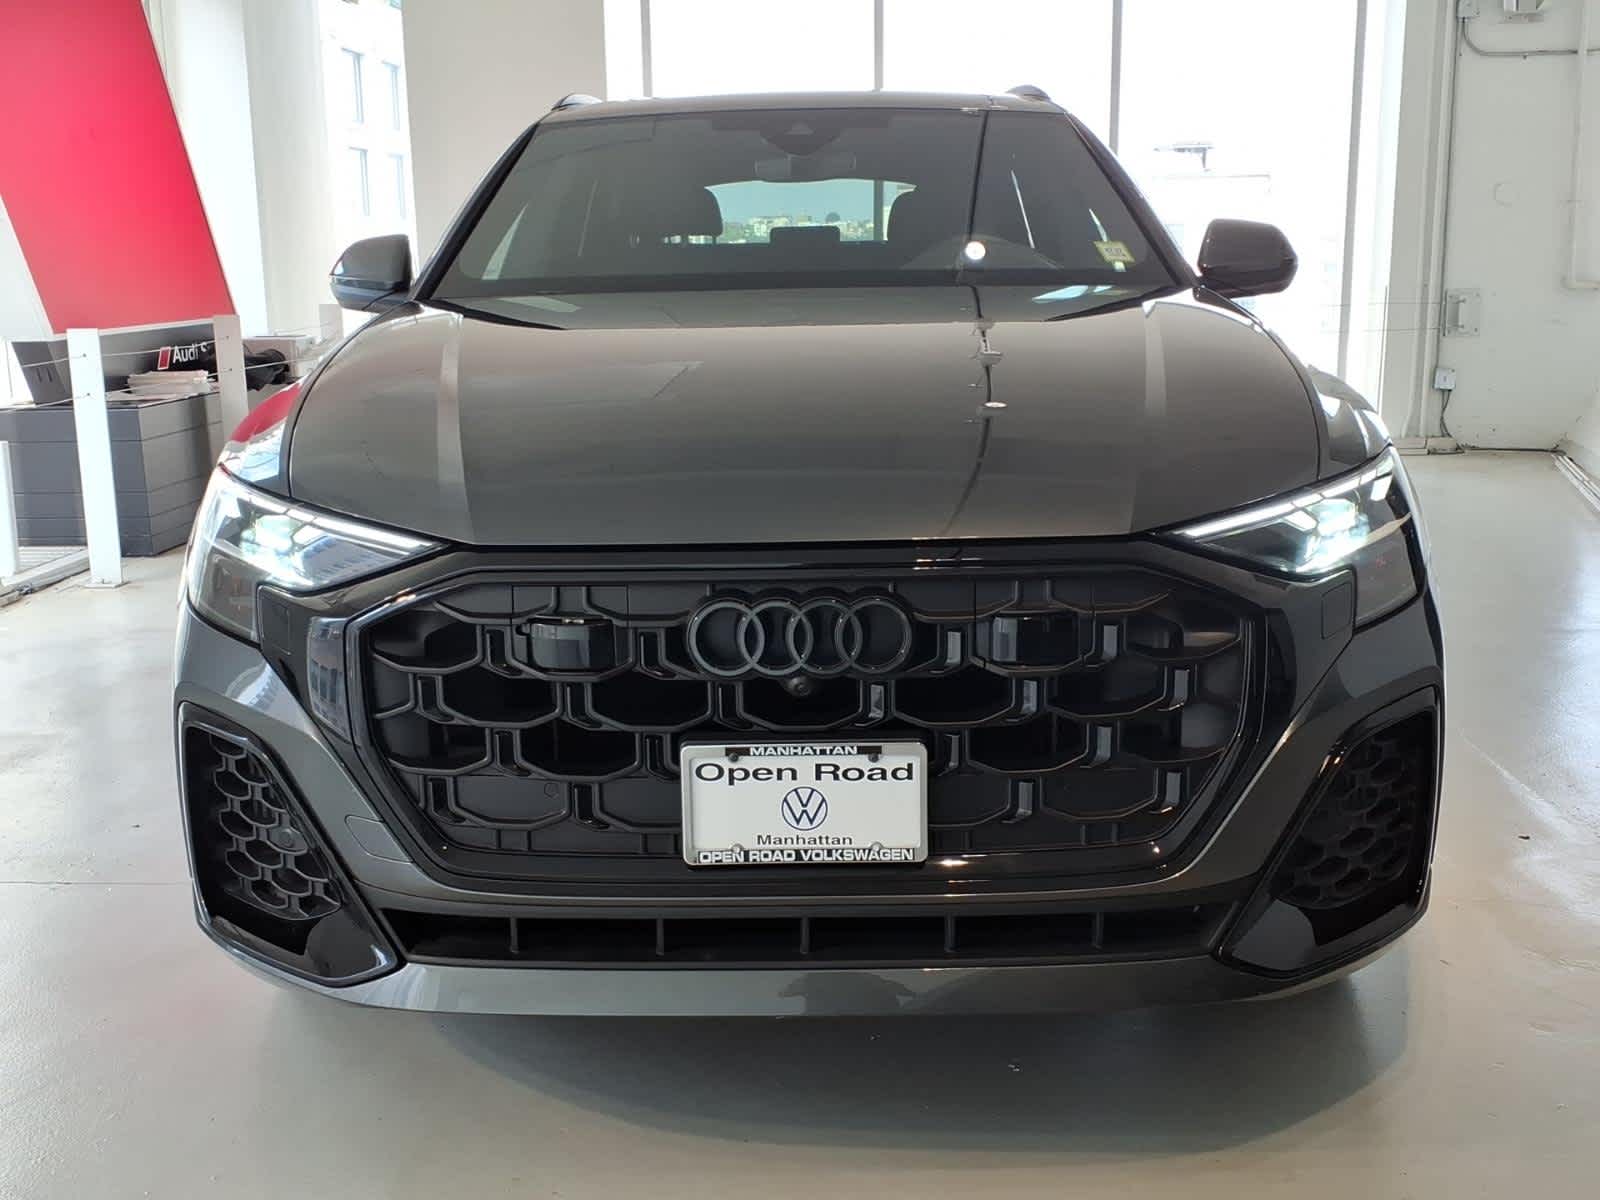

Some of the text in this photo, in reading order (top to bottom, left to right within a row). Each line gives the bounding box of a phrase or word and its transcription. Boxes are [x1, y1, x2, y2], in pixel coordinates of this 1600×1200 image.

[172, 343, 199, 363] Audi
[749, 746, 858, 756] MANHATTAN
[695, 763, 914, 785] Open Road
[757, 834, 853, 846] Manhattan
[699, 849, 914, 863] OPEN ROAD VOLKSWAGEN
